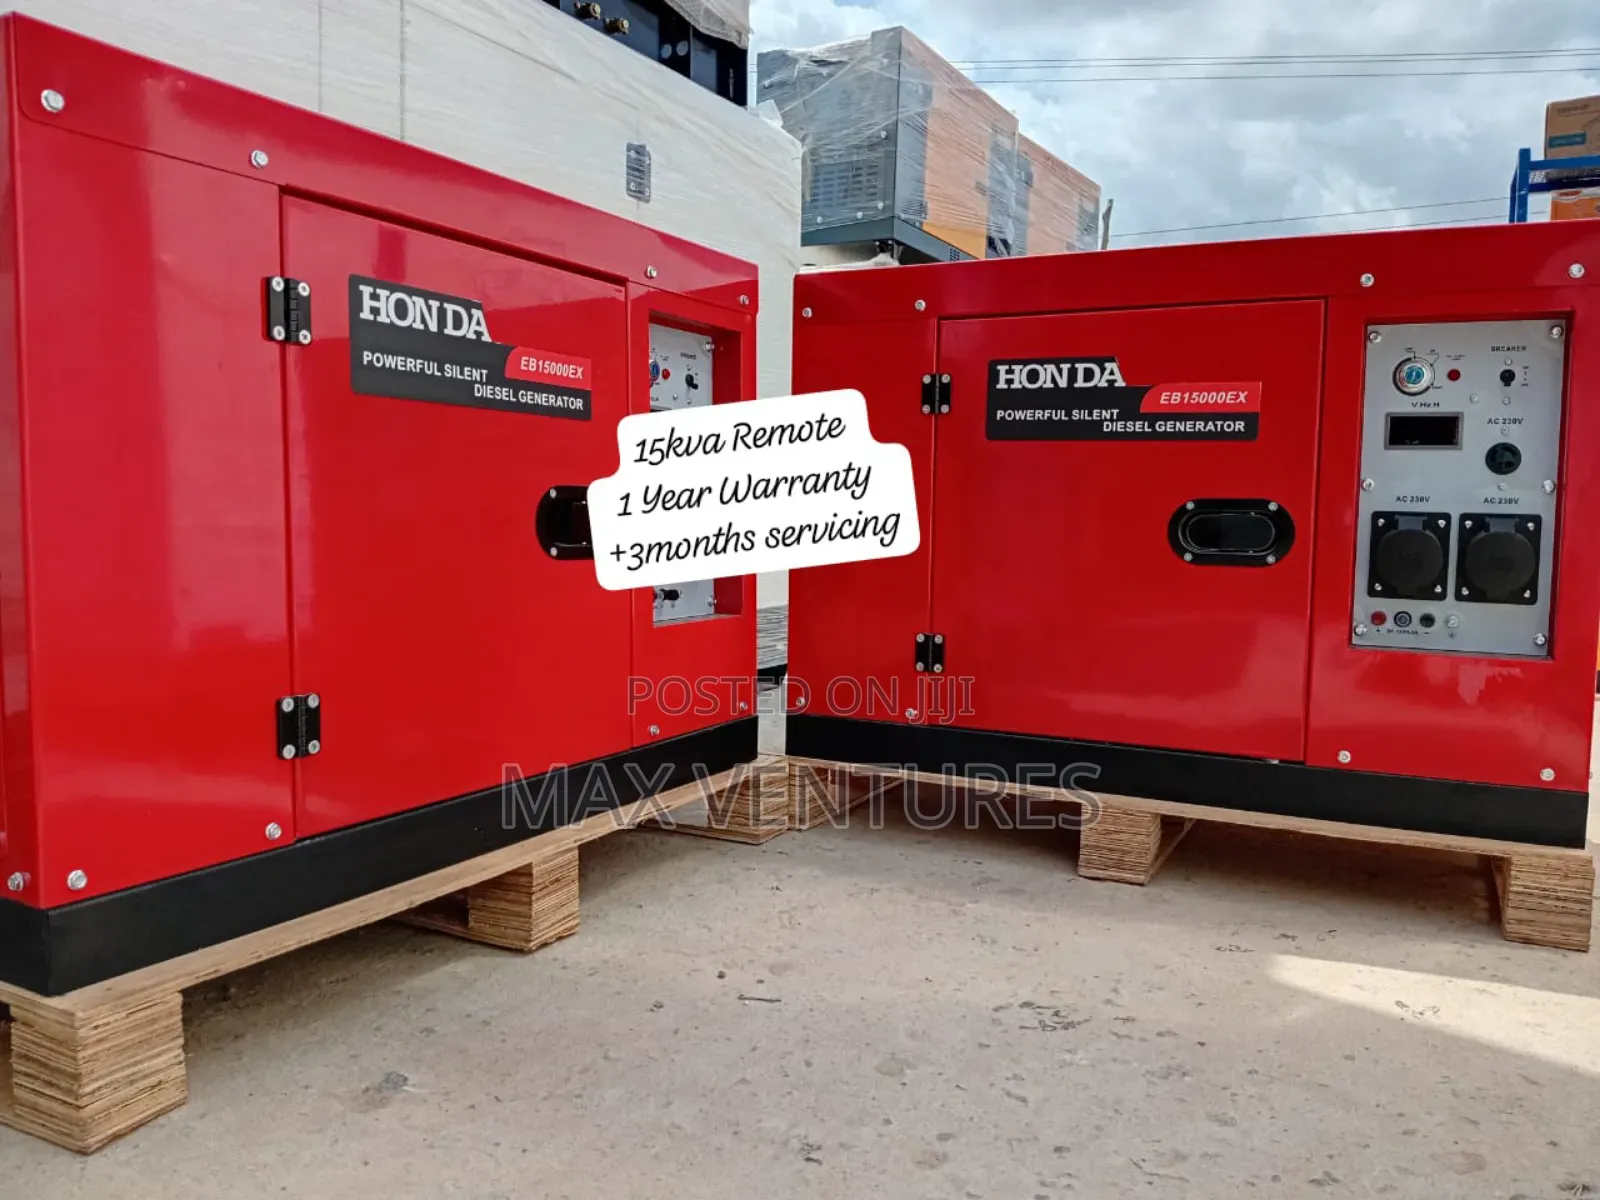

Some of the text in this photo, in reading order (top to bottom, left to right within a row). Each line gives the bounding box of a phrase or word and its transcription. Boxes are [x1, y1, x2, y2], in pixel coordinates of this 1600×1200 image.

[362, 350, 489, 383] POWERFUL SILENT
[520, 355, 585, 380] EB15000EX
[474, 383, 584, 411] DIESEL GENERATOR
[1159, 391, 1248, 405] EB15000EX
[996, 409, 1119, 421] POWERFUL SILENT
[1103, 421, 1245, 433] DIESEL GENERATOR
